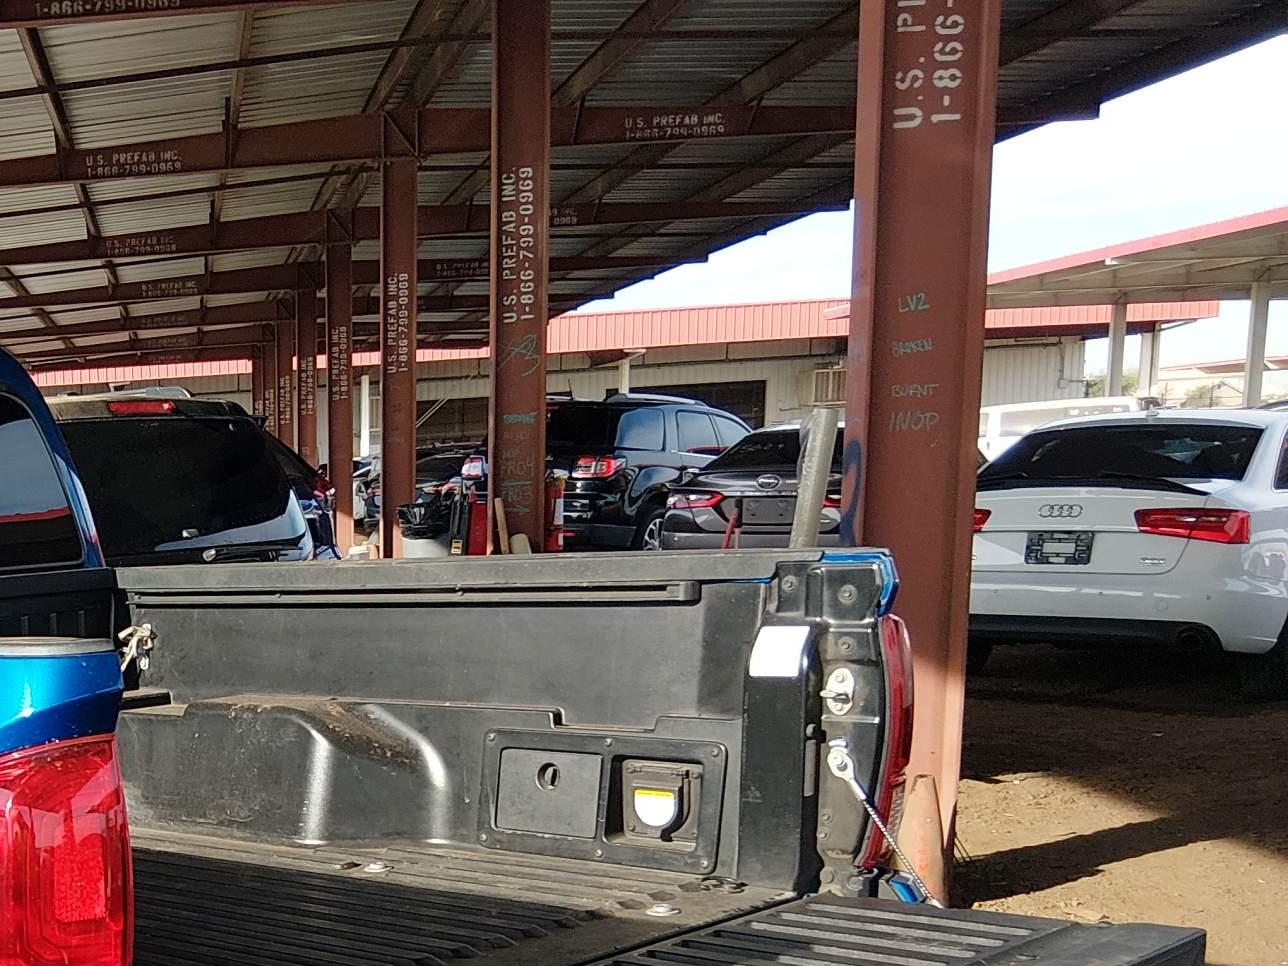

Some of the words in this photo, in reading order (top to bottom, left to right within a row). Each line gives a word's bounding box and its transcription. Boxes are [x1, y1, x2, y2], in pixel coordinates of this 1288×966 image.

[893, 57, 925, 128] U.S.
[625, 116, 647, 129] U.S.
[653, 113, 698, 127] PREFAB
[703, 112, 726, 125] INC.
[86, 154, 107, 167] U.S.
[113, 151, 156, 165] PREFAB
[160, 149, 183, 161] INC.
[501, 167, 517, 202] INC.
[501, 210, 517, 280] PREFAB
[519, 167, 535, 321] 1-866-799-0969
[386, 273, 398, 296] INC.
[502, 289, 518, 324] U.S.
[898, 292, 931, 313] LV2
[386, 302, 398, 345] PREFAB
[386, 350, 398, 374] U.S.
[888, 410, 940, 433] INOP
